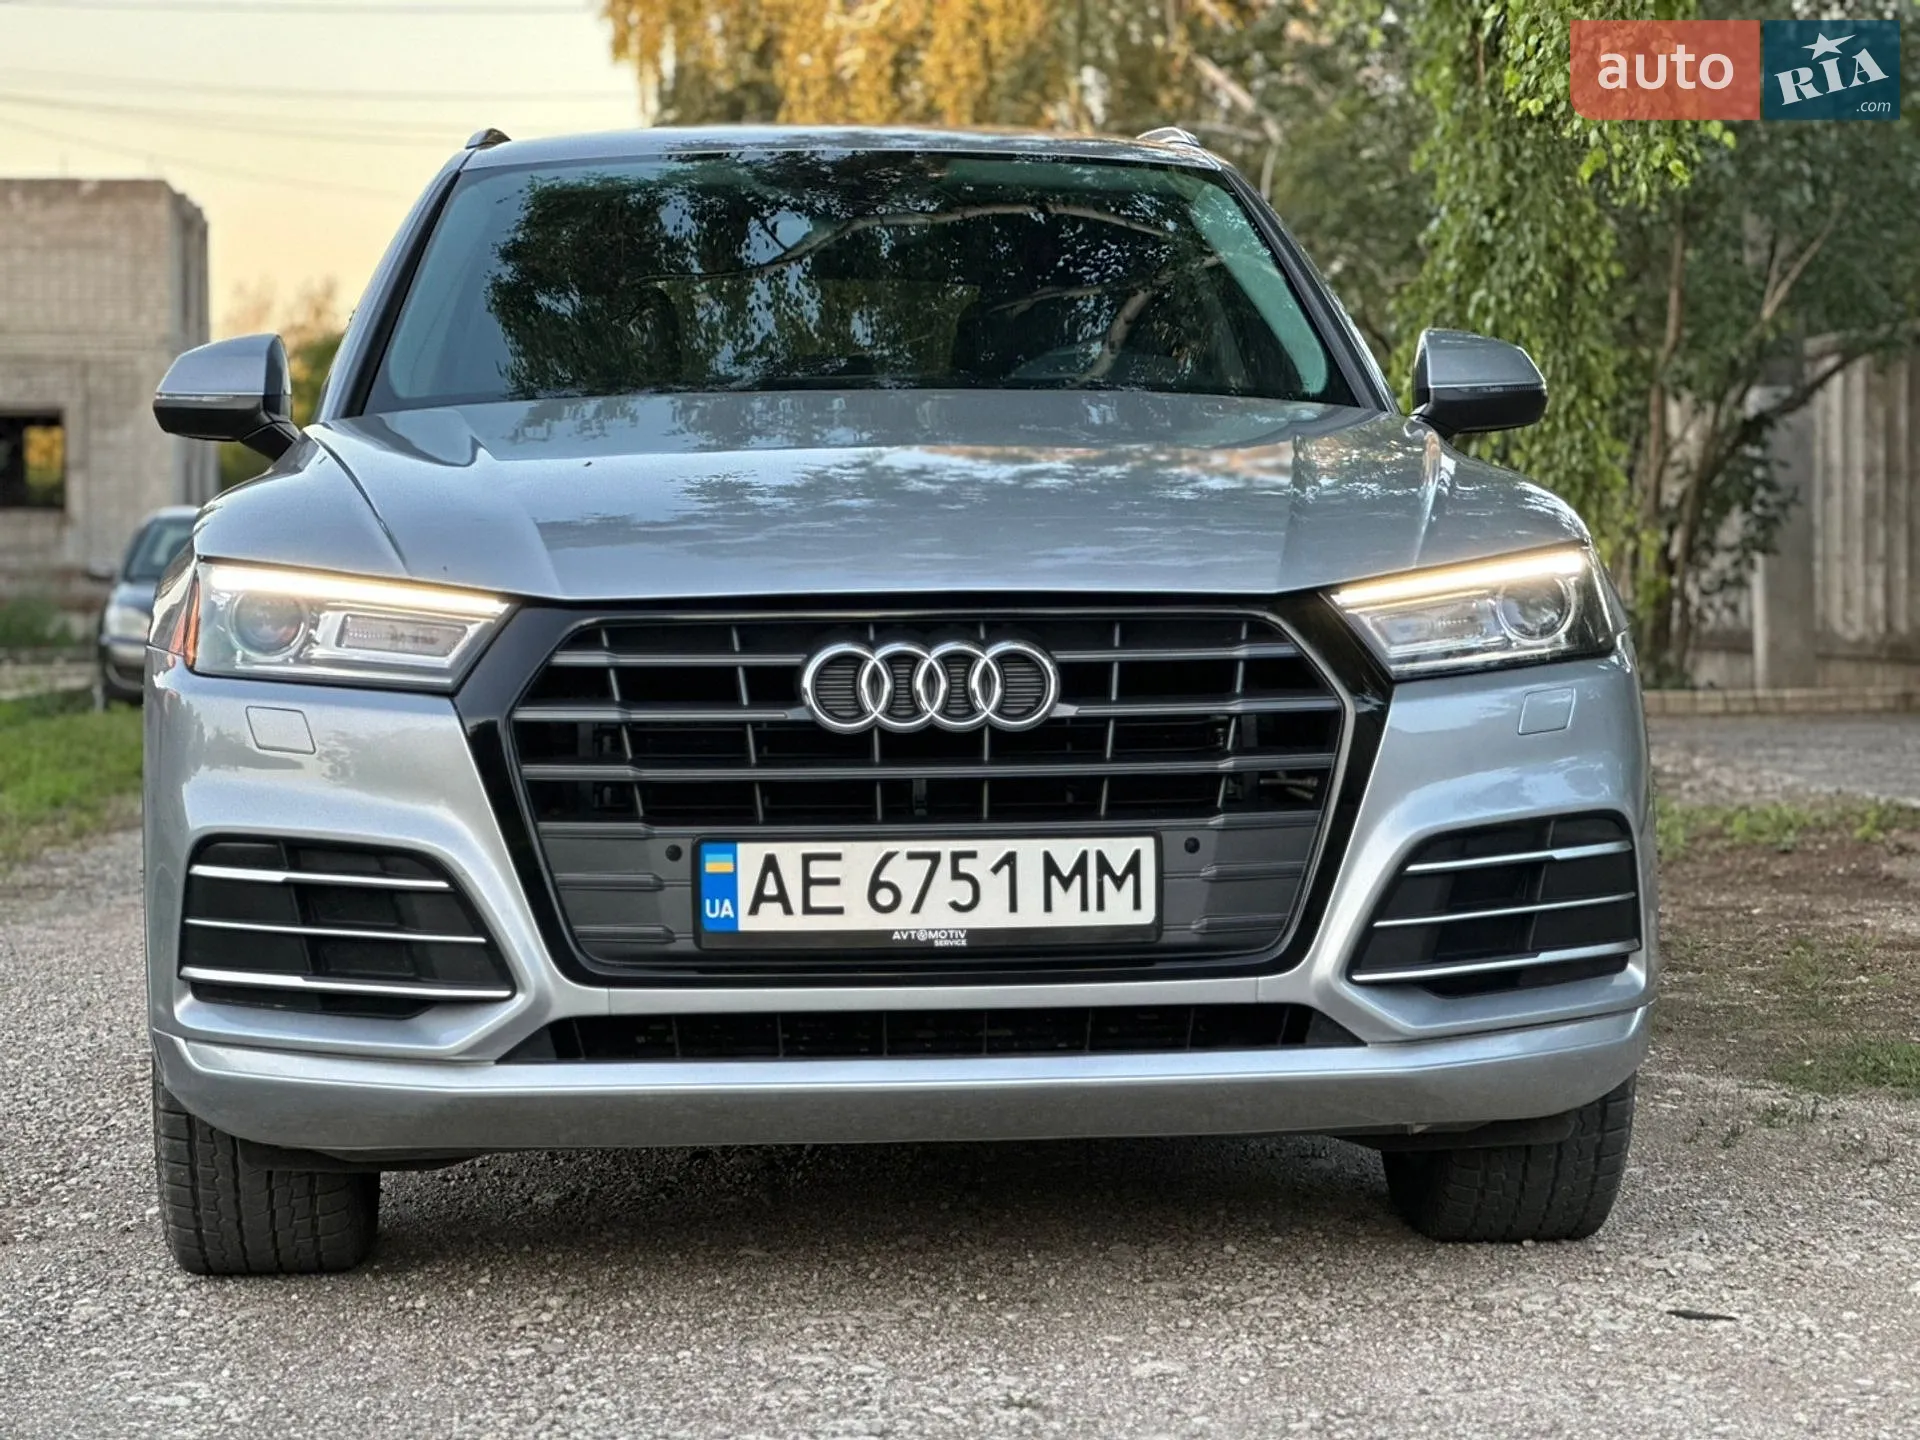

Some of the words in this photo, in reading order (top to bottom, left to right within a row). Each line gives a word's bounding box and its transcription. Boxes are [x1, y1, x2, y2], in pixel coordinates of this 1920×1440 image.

[748, 852, 845, 916] AE
[867, 850, 1018, 914] 6751
[1043, 849, 1142, 912] MM
[705, 898, 735, 918] UA
[934, 939, 967, 947] SERVICE
